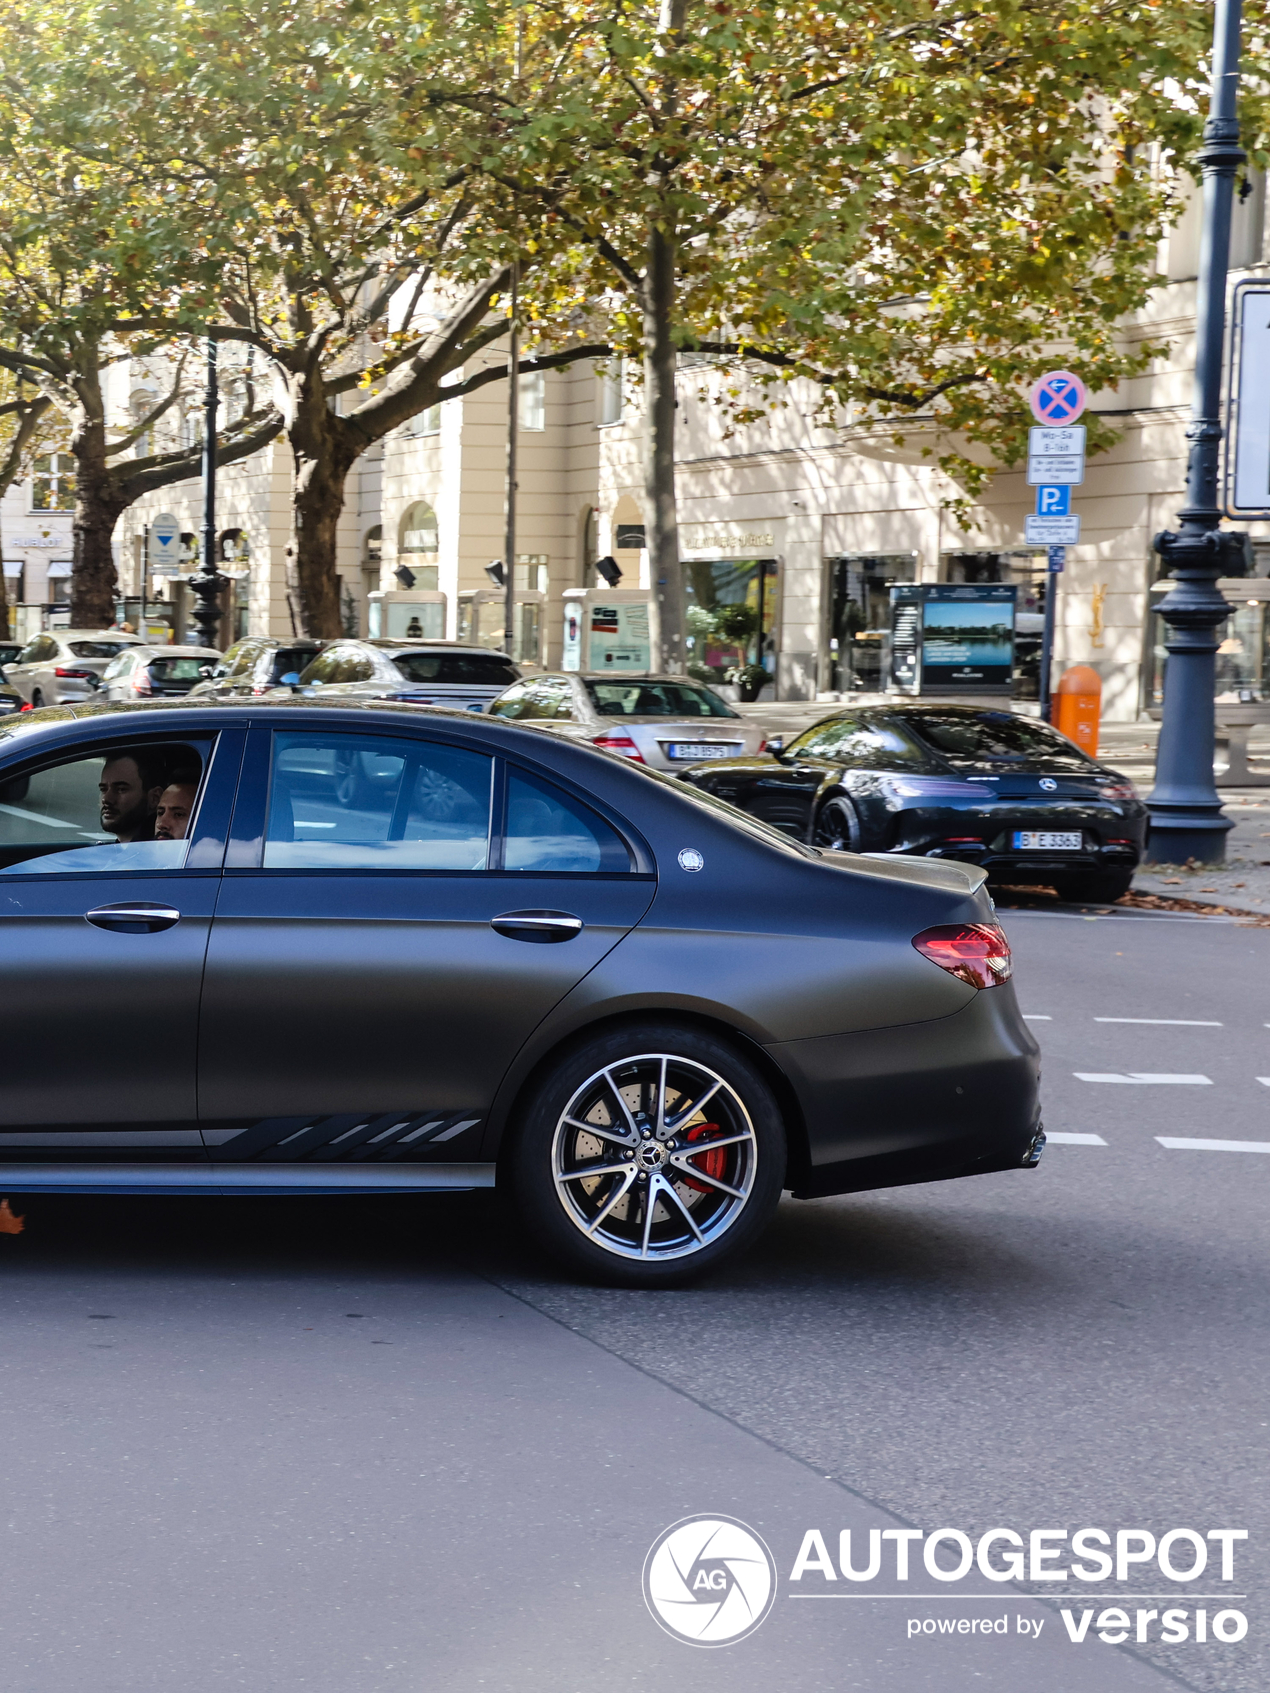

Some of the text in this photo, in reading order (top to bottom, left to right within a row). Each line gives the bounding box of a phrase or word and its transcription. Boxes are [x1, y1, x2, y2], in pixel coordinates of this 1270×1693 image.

[1040, 487, 1061, 513] P
[11, 538, 62, 548] HUBLOT
[1022, 834, 1030, 847] B
